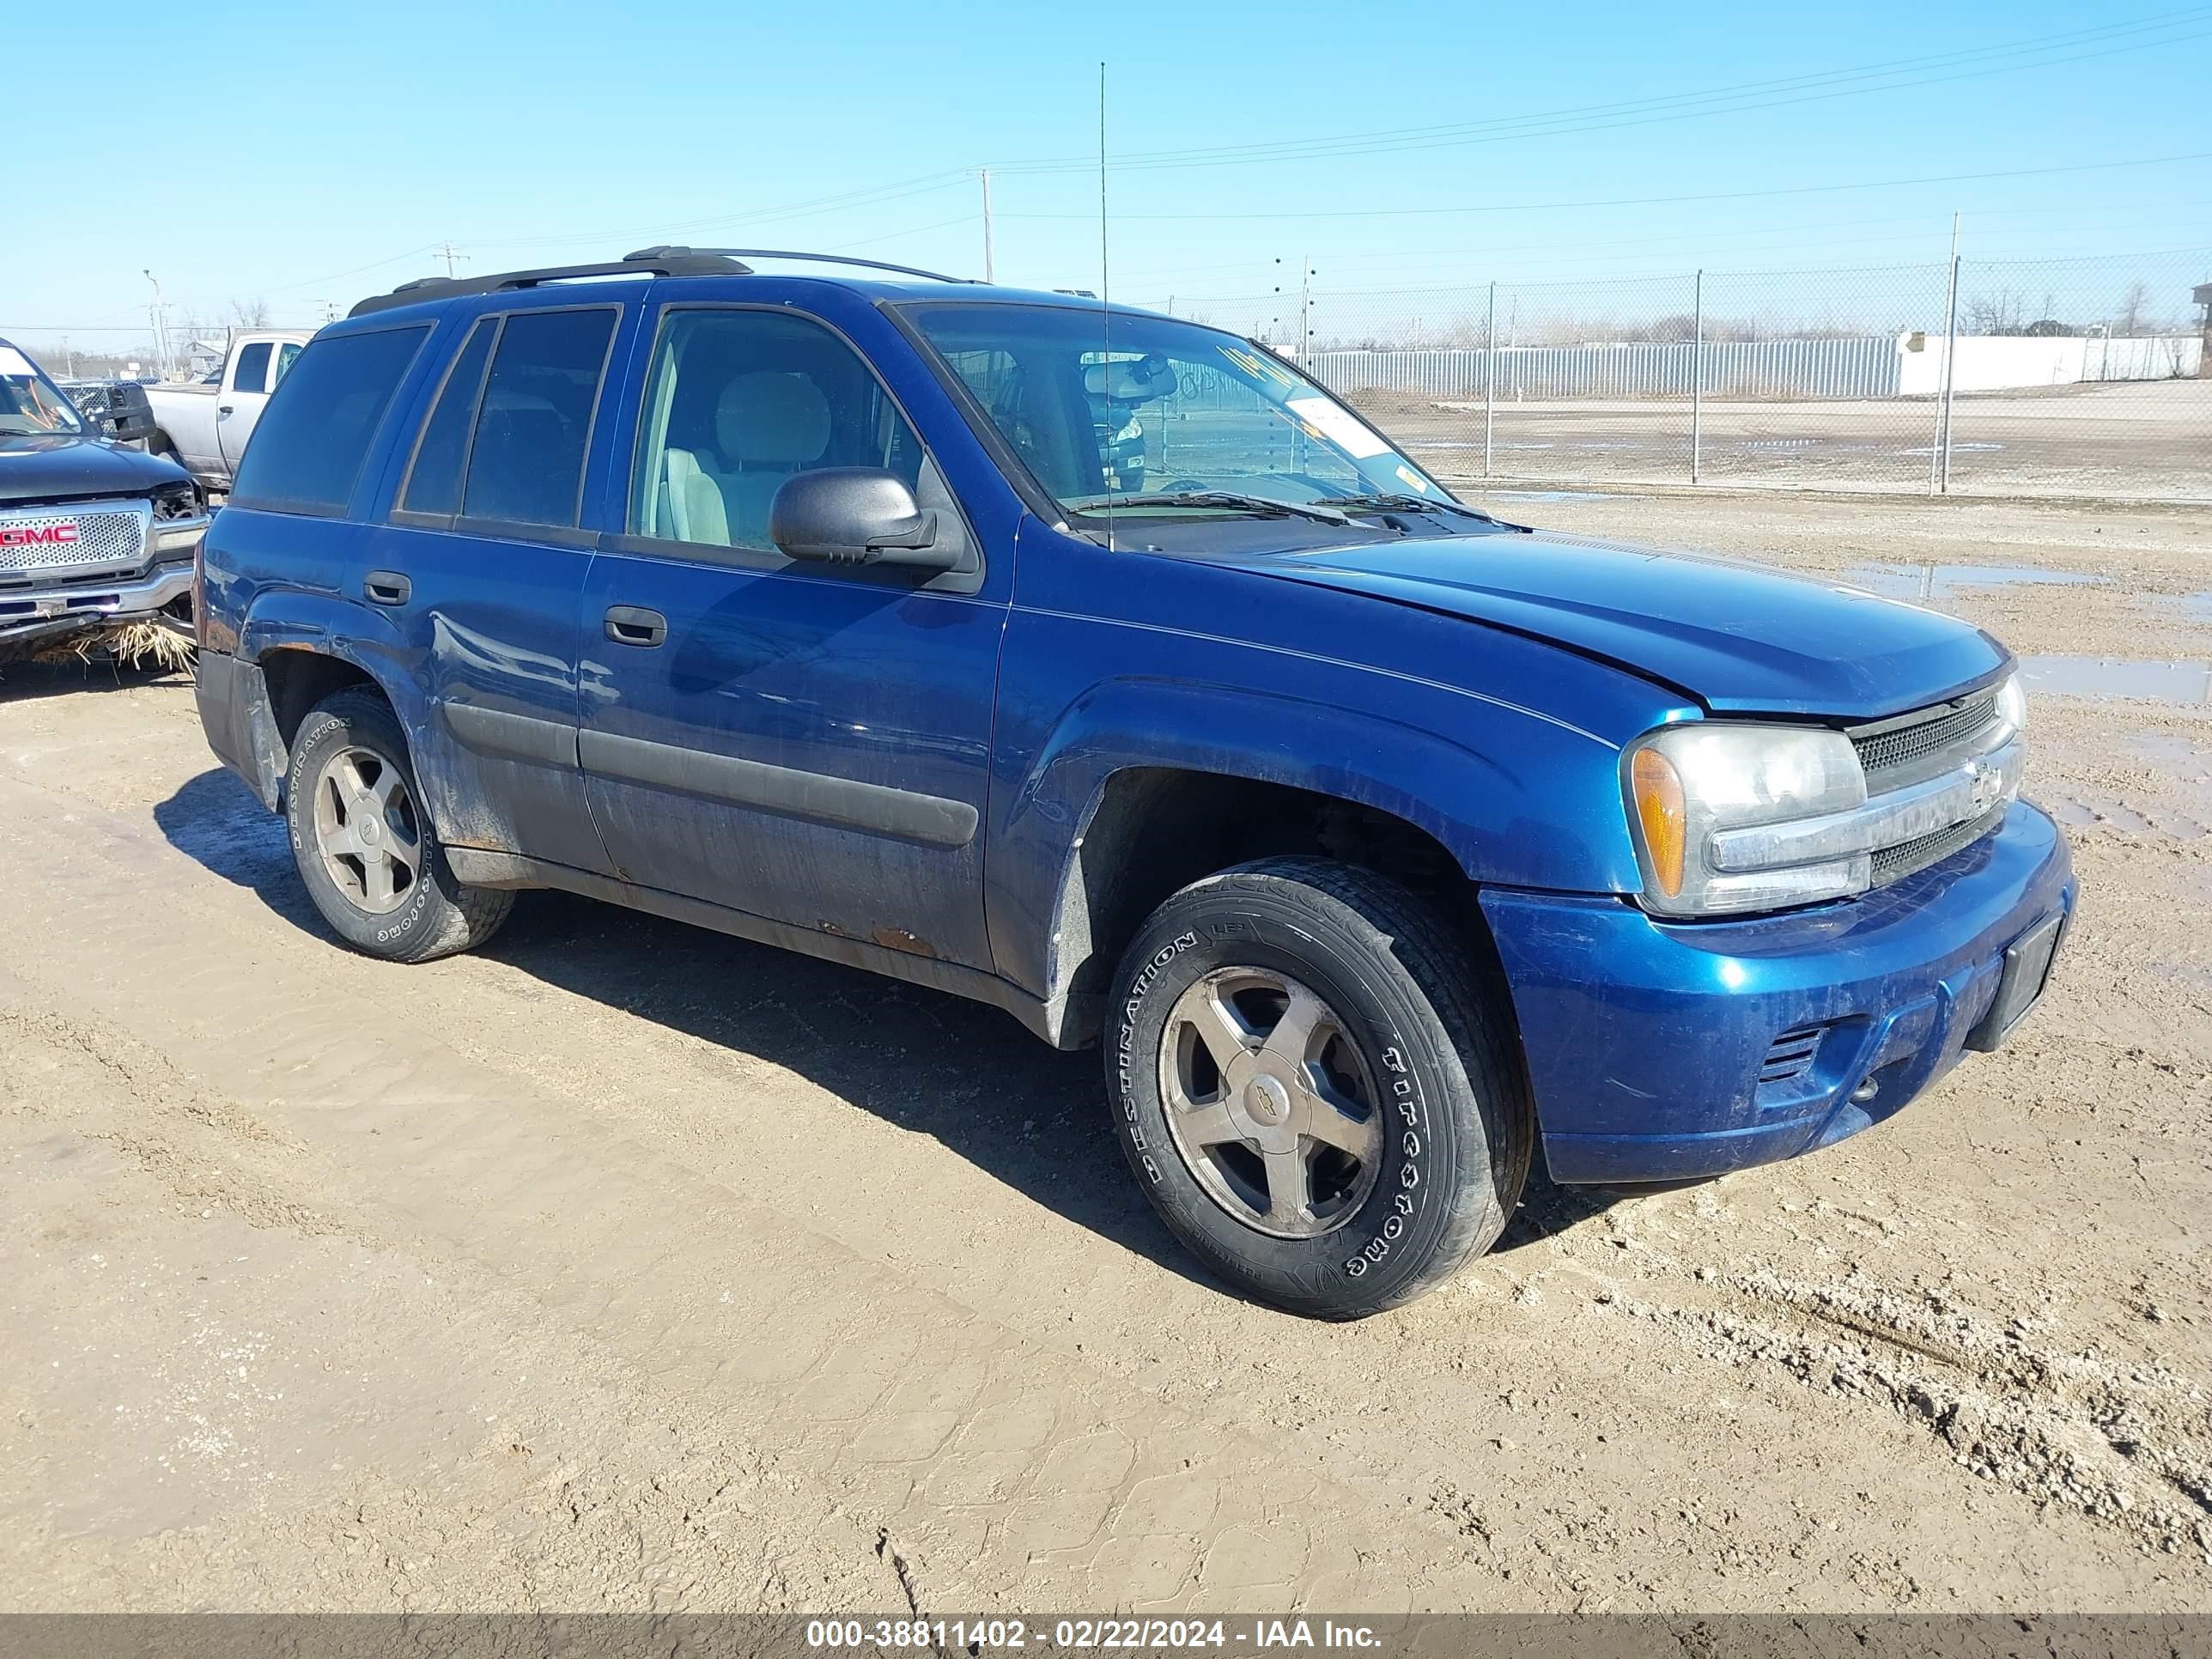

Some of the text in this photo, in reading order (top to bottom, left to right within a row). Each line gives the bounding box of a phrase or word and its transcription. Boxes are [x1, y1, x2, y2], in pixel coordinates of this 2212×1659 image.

[0, 523, 78, 547] GMC
[289, 717, 351, 849] DESTINATION
[1119, 931, 1198, 1184] DESTINATION
[1346, 1046, 1420, 1277] Firestone
